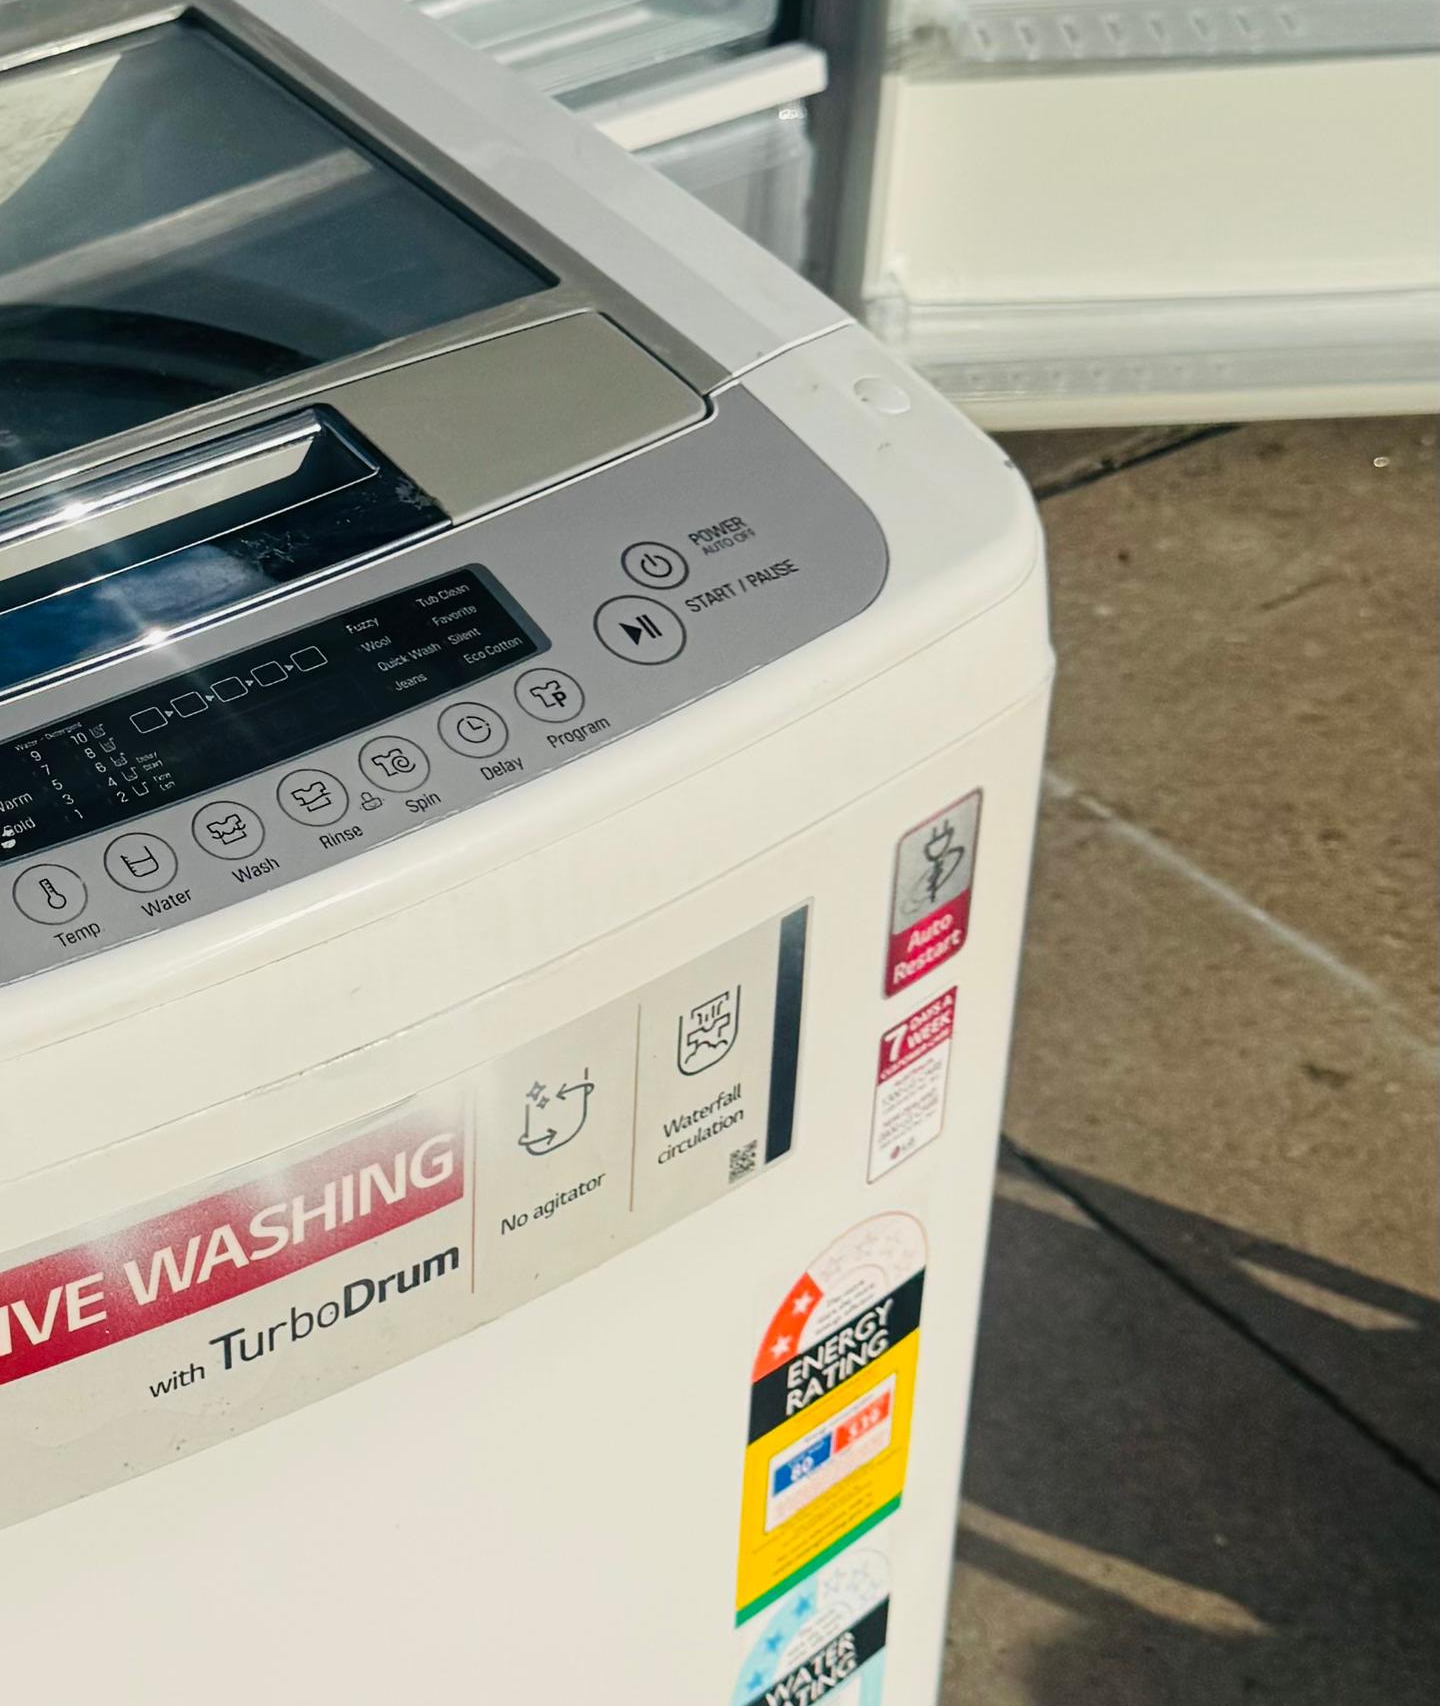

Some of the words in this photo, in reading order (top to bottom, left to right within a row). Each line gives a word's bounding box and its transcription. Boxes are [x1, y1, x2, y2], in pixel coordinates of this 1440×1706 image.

[688, 516, 747, 546] POWER
[415, 595, 439, 608] Tub
[438, 583, 470, 601] Clean
[684, 583, 737, 613] START
[745, 558, 800, 587] PAUSE
[345, 616, 380, 634] Fuzzy
[431, 604, 478, 627] Favorite
[360, 635, 392, 653] Wool
[447, 627, 482, 645] Silent
[377, 653, 410, 672] Quick
[408, 642, 442, 661] Wash
[463, 650, 487, 665] Eco
[485, 635, 524, 656] Cotton
[394, 672, 428, 692] Jeans
[70, 732, 88, 746] 10
[546, 717, 611, 749] Program
[30, 750, 42, 763] 9
[84, 747, 97, 759] 8
[40, 764, 52, 776] 7
[95, 761, 107, 773] 6
[479, 755, 525, 782] Delay
[51, 779, 63, 791] 5
[107, 776, 118, 788] 4
[62, 793, 75, 806] 3
[116, 791, 129, 804] 2
[405, 791, 442, 815] Spin
[74, 808, 85, 820] 1
[318, 823, 364, 850] Rinse
[231, 857, 280, 884] Wash
[140, 888, 193, 918] Water
[53, 921, 101, 948] Temp
[906, 913, 954, 954] Auto
[892, 928, 963, 985] Restart
[883, 1023, 909, 1064] 7
[662, 1082, 742, 1139] Waterfall
[657, 1108, 745, 1165] circulation
[500, 1212, 529, 1236] No
[532, 1172, 607, 1220] agitator
[123, 1132, 457, 1307] WASHING
[149, 1362, 205, 1398] with
[208, 1245, 460, 1371] TurboDrum
[786, 1297, 895, 1390] ENERGY
[785, 1327, 891, 1417] RATING
